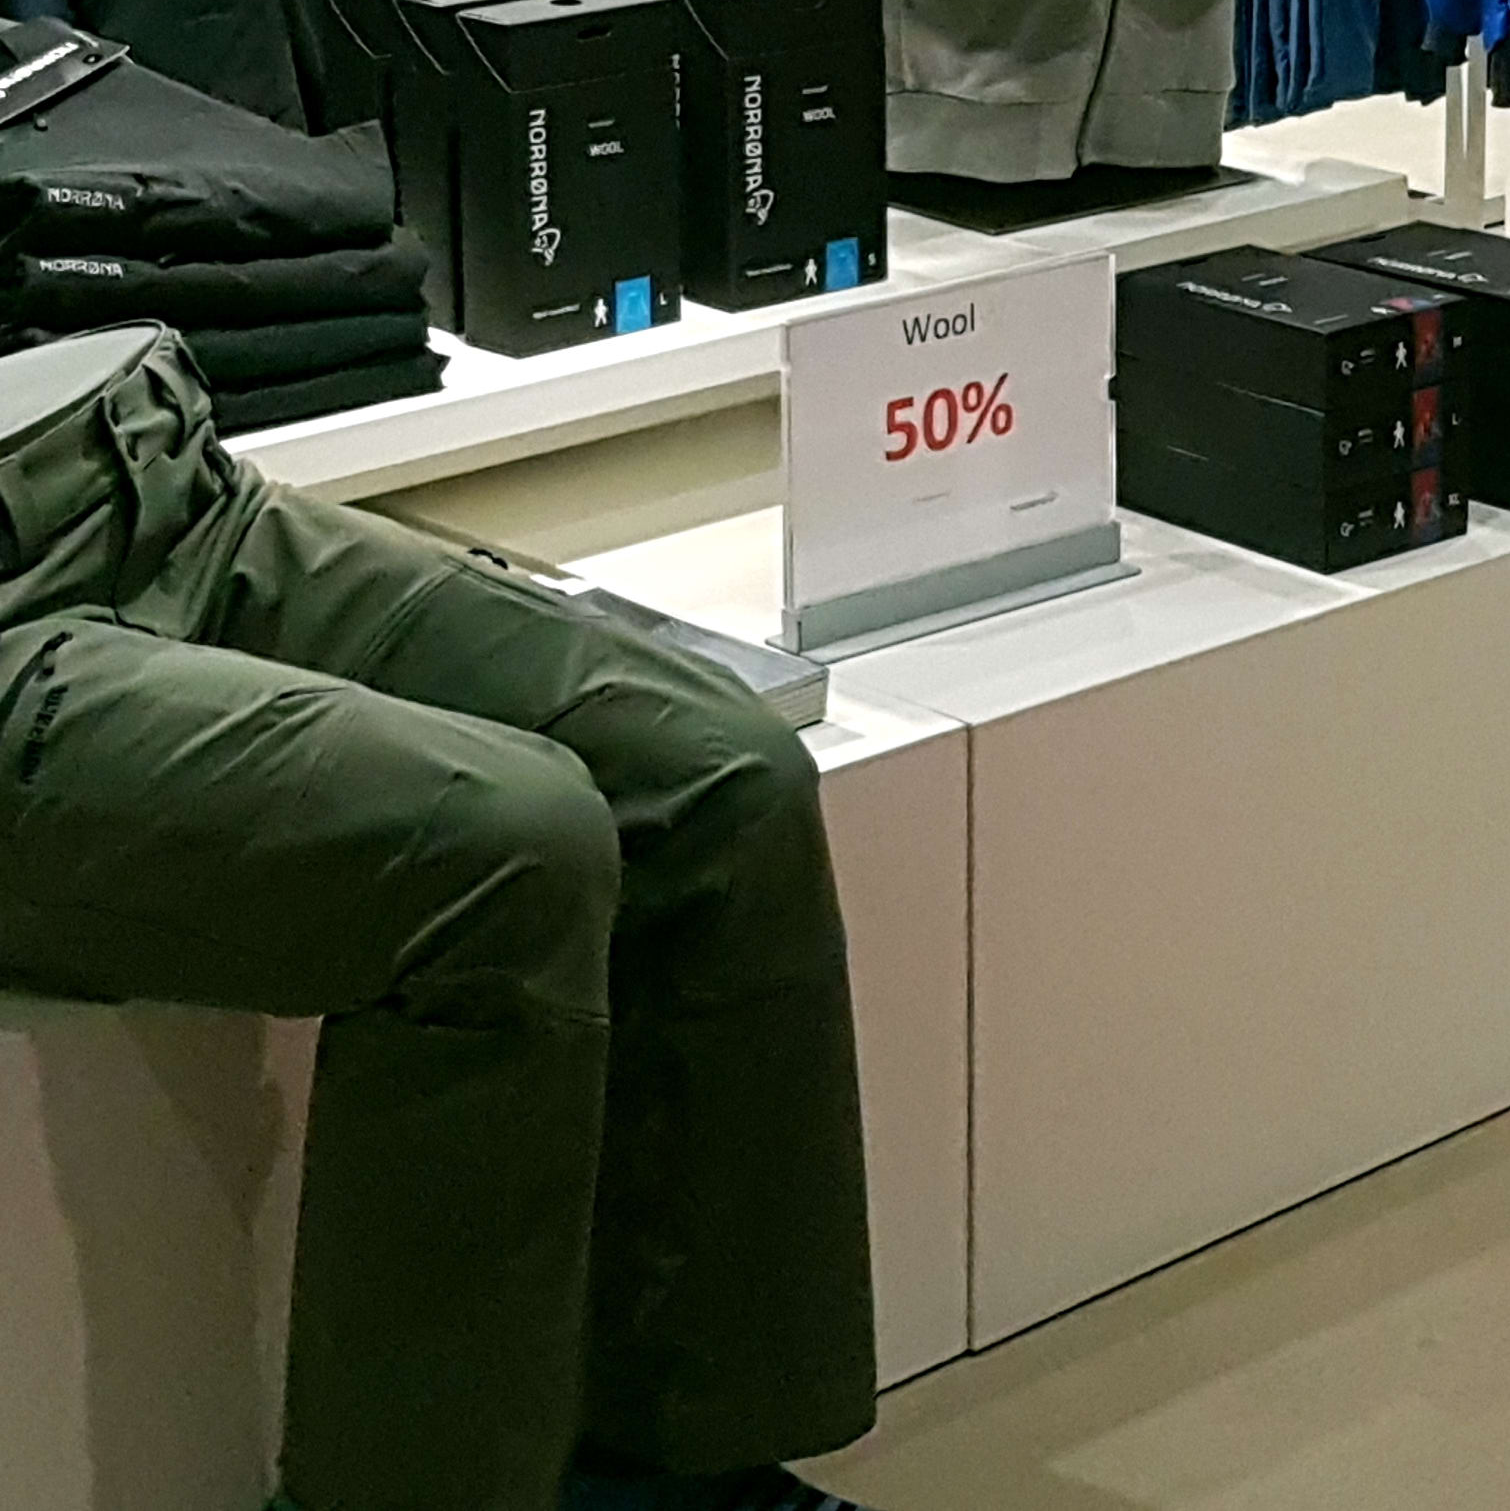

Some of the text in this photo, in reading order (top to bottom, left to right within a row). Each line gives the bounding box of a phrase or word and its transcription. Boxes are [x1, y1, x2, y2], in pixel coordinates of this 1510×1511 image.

[528, 108, 550, 232] NORRØNA
[588, 141, 625, 157] WOOL
[743, 74, 763, 192] NORRØNA
[902, 302, 976, 346] Wool
[884, 372, 1015, 462] 50%
